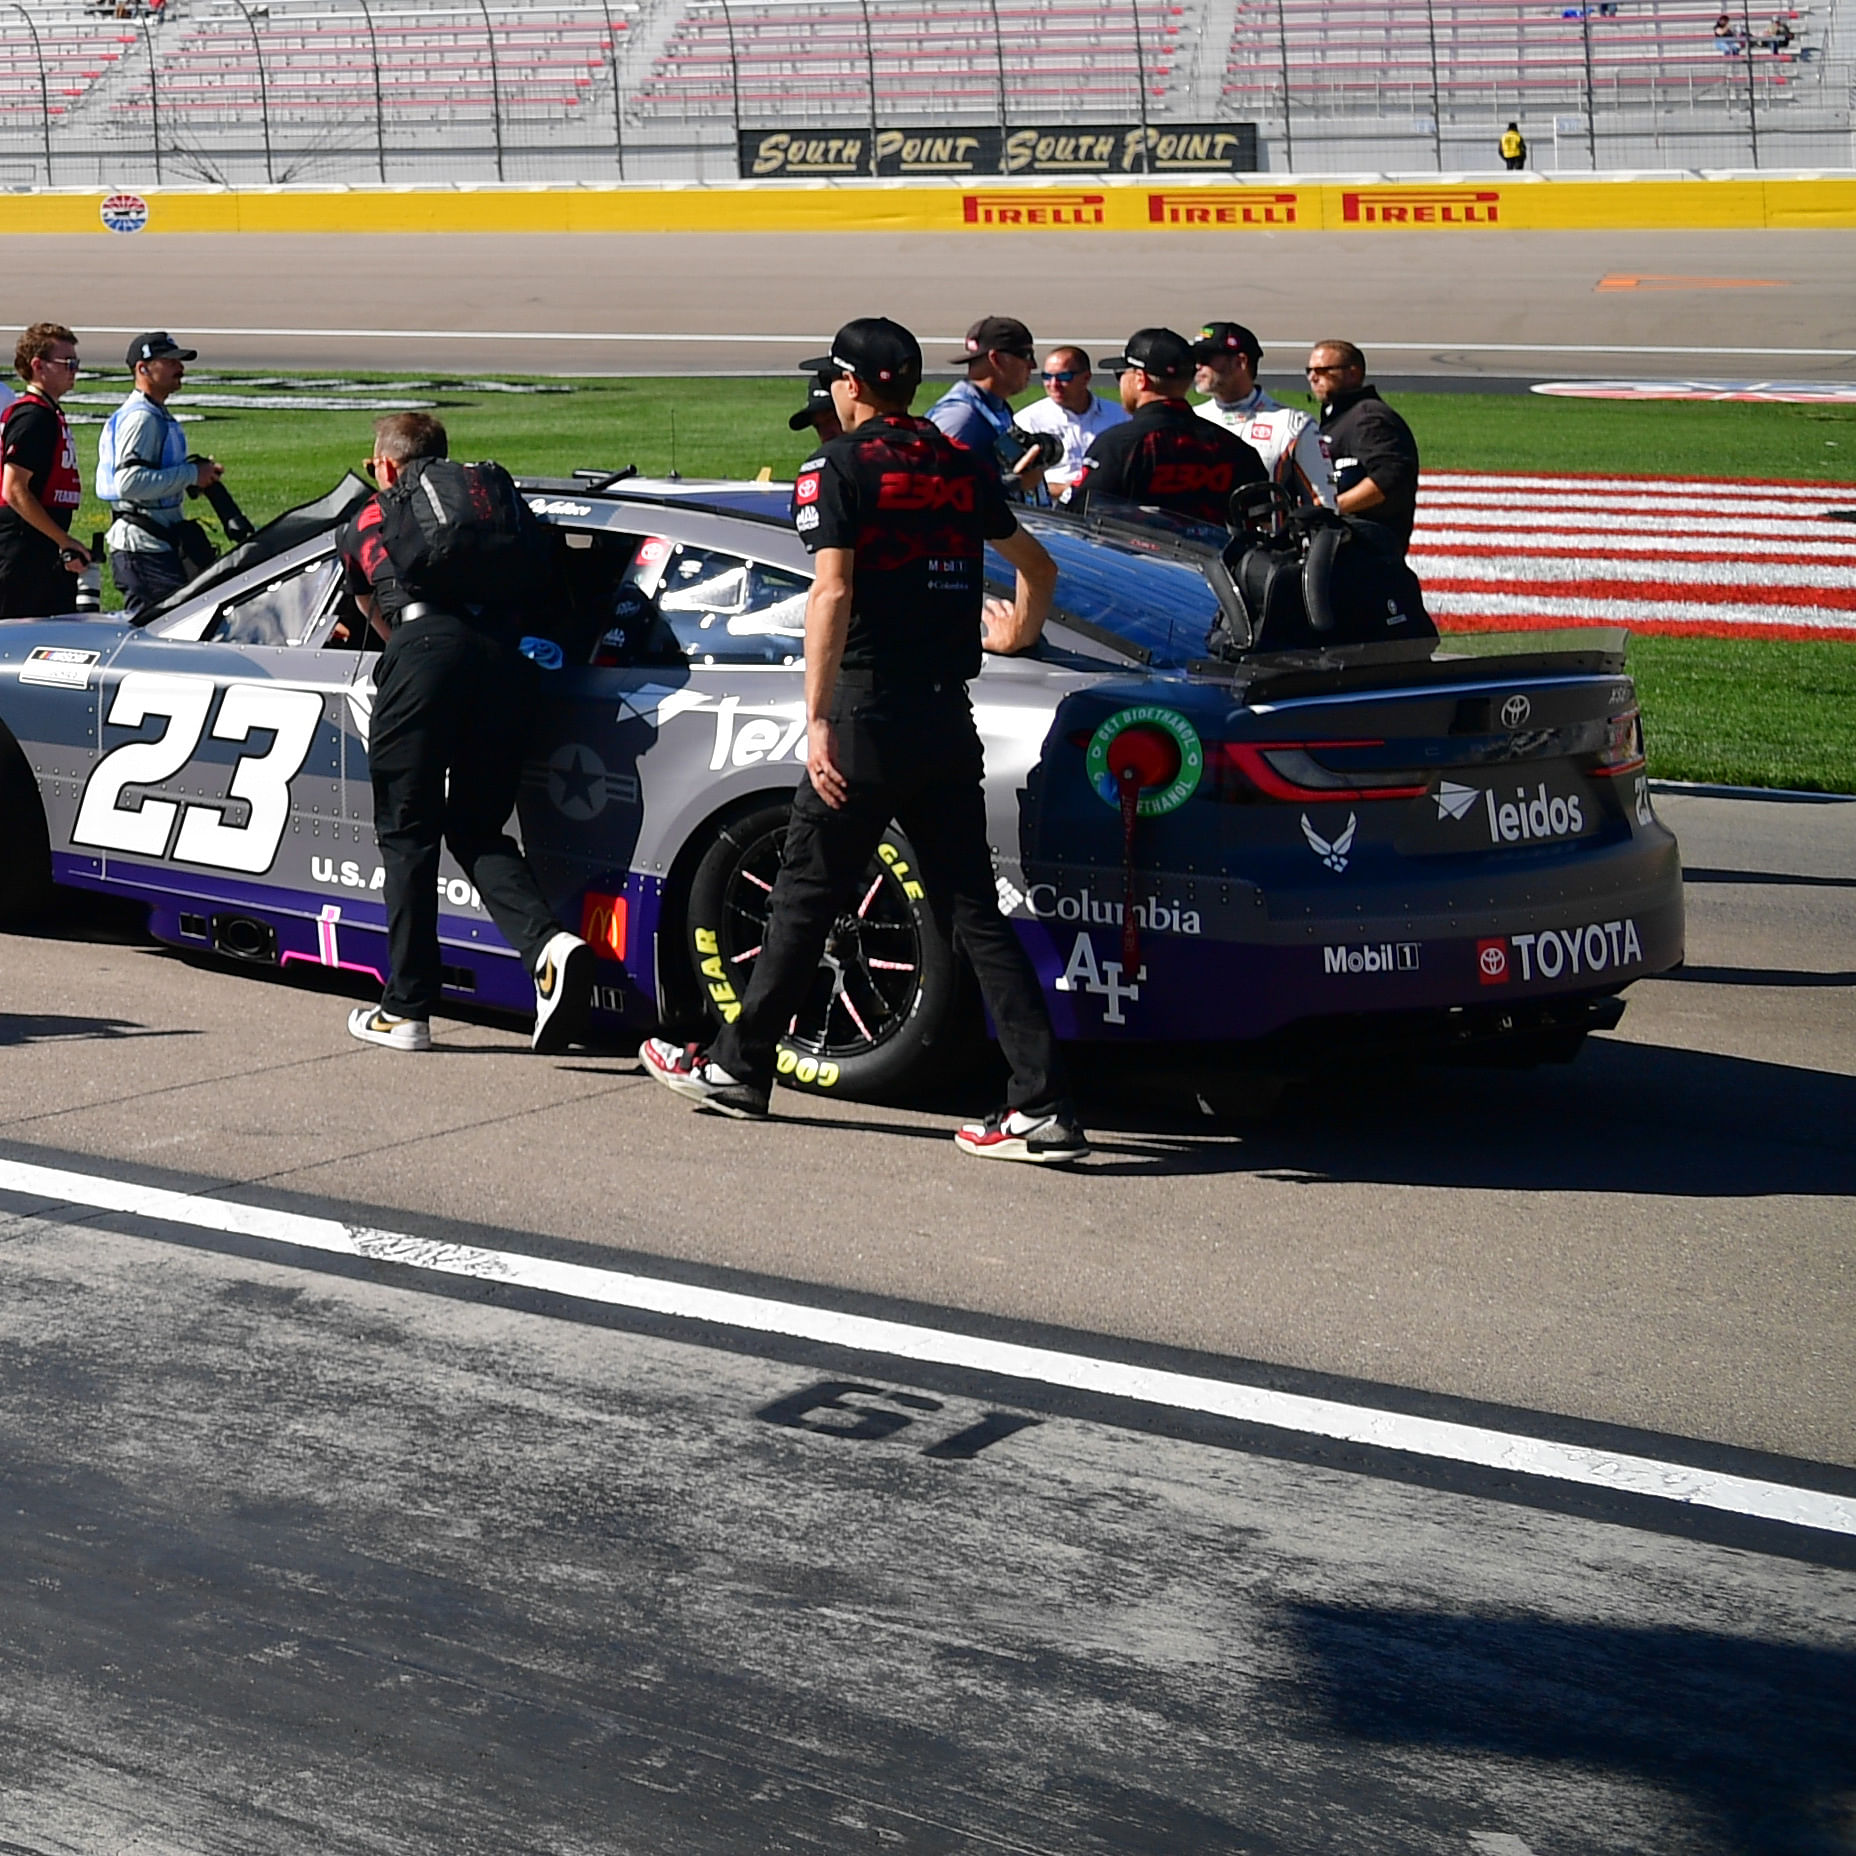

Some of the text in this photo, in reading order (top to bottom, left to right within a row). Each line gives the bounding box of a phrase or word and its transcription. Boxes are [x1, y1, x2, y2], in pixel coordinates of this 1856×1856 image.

[753, 134, 979, 173] SOUTH POINT
[1003, 132, 1239, 172] SOUTH POINT
[963, 195, 1106, 224] PIRELLI
[1148, 194, 1298, 224] PIRELLI
[1343, 192, 1500, 223] PIRELLI
[1099, 706, 1197, 747] GET BIOETHANOL
[70, 671, 325, 875] 23
[1486, 782, 1584, 843] leidos
[309, 857, 366, 889] U.S.
[1323, 944, 1394, 974] Mobil
[1511, 918, 1643, 981] TOYOTA
